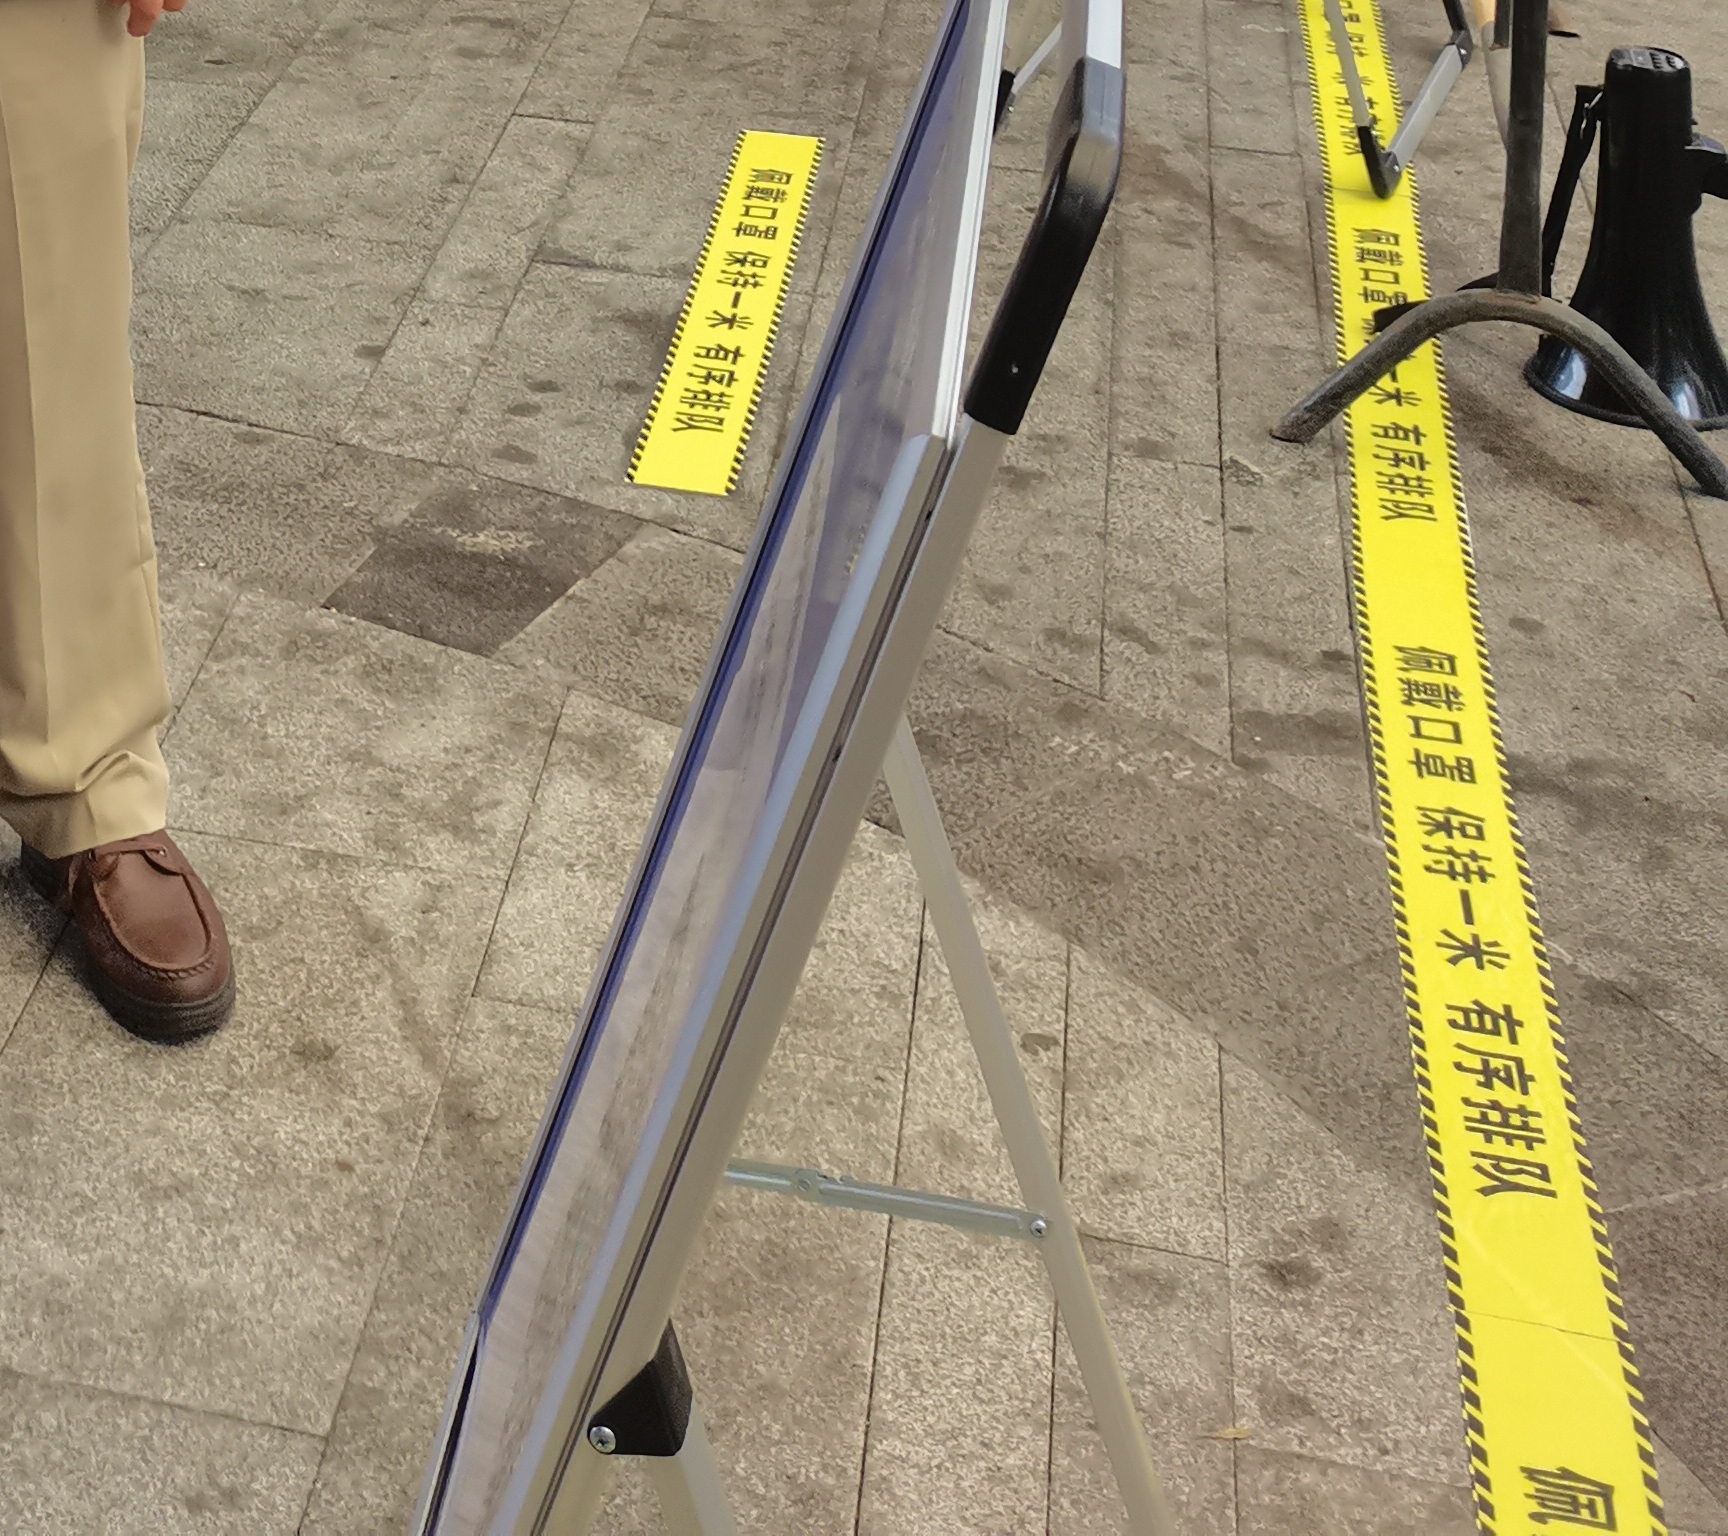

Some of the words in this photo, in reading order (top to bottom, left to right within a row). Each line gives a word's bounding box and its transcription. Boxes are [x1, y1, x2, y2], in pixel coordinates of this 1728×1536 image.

[731, 167, 795, 241] 佩戴口罩
[705, 250, 772, 330] 保持一米
[671, 343, 746, 433] 有序排队
[1370, 421, 1438, 523] 有序排队
[1392, 644, 1478, 785] 佩戴口罩
[1416, 805, 1511, 972] 保持一米
[1444, 997, 1558, 1200] 有序排队
